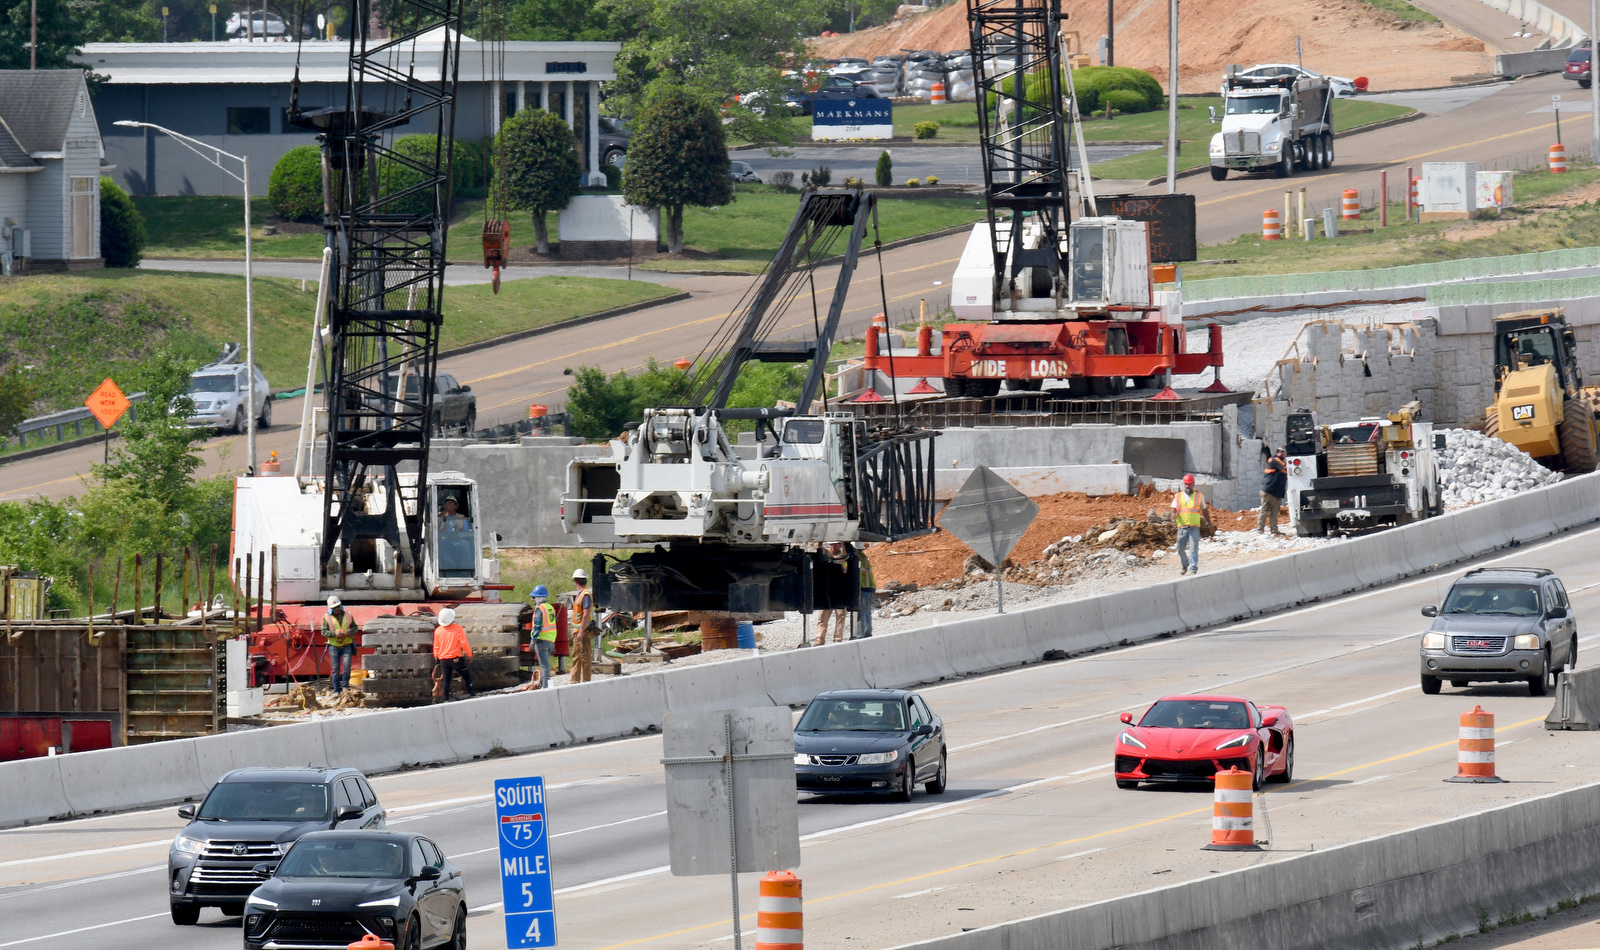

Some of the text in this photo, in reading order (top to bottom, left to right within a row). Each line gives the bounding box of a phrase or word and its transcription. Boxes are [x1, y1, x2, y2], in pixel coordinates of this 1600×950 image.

[816, 110, 889, 118] MARKMANS
[1111, 198, 1162, 217] WORK
[970, 359, 1068, 377] WIDE LOAD
[1513, 405, 1533, 419] CAT
[497, 785, 543, 808] SOUTH
[512, 823, 533, 841] 75
[503, 855, 547, 877] MILE
[521, 882, 534, 908] 5
[520, 917, 542, 945] .4
